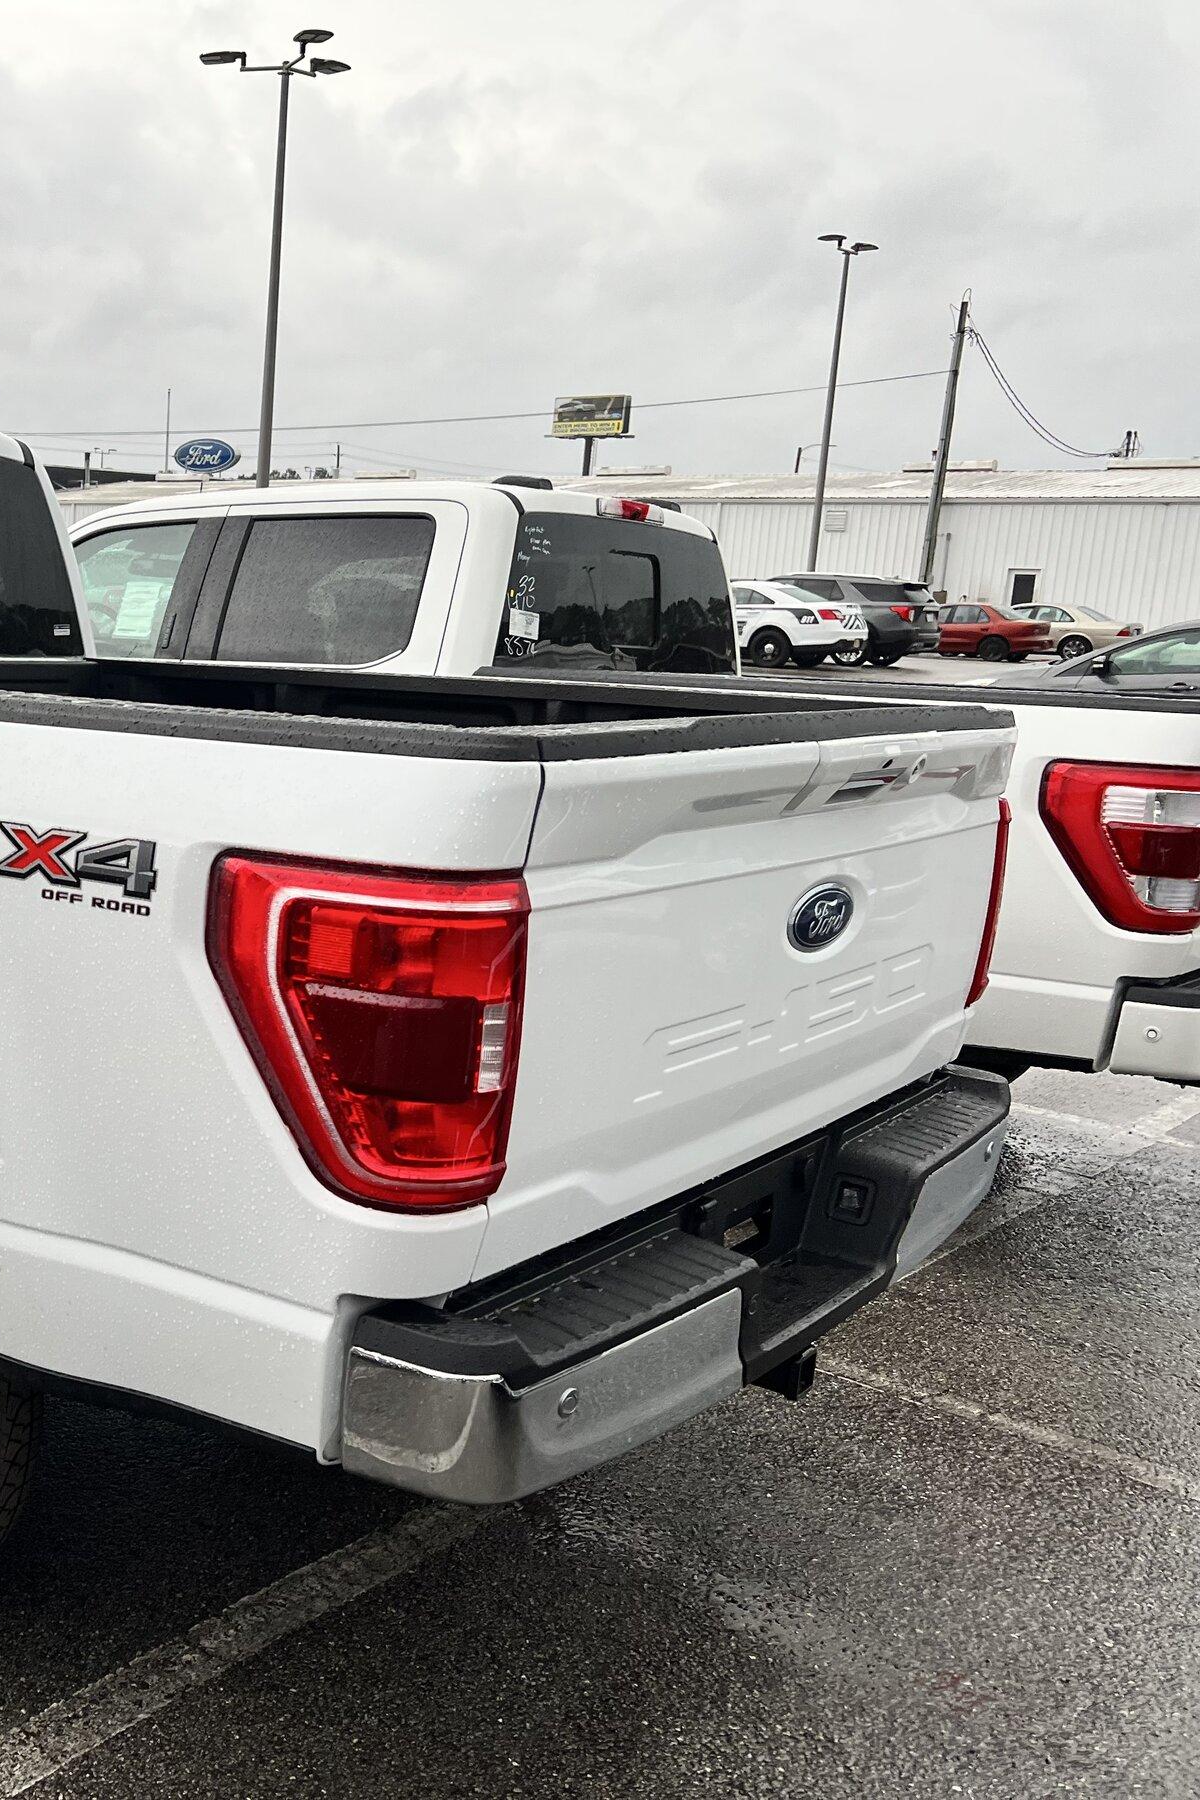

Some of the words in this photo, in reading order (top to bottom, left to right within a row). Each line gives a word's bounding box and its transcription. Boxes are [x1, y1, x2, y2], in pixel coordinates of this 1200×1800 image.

[180, 445, 222, 465] Ford
[518, 575, 535, 596] 32
[800, 615, 815, 624] 911
[41, 888, 84, 905] OFF
[91, 896, 151, 917] ROAD
[808, 898, 846, 939] Ford
